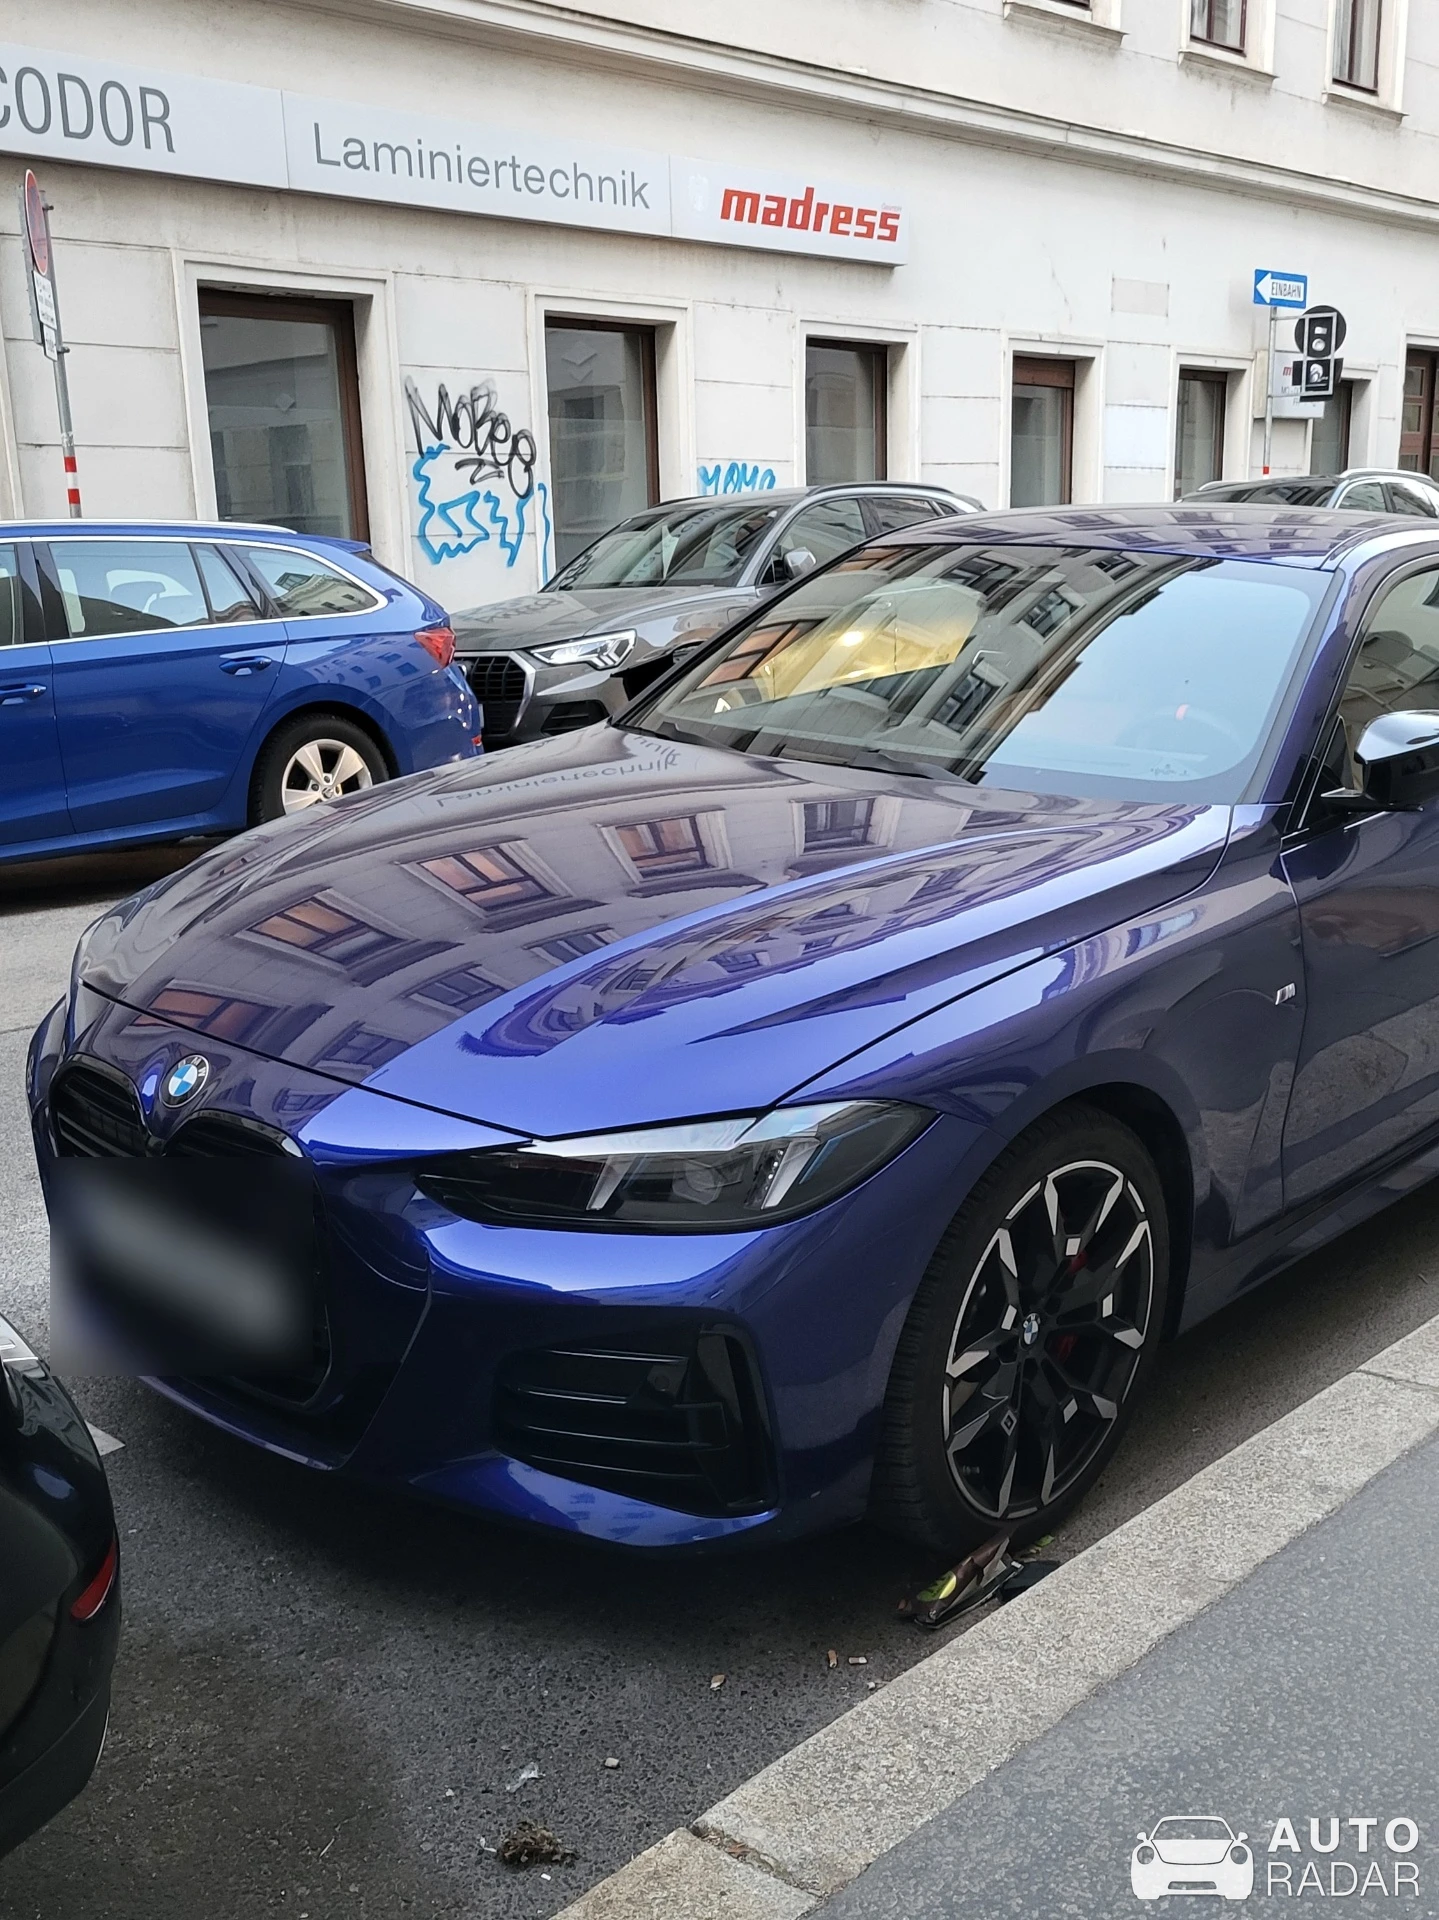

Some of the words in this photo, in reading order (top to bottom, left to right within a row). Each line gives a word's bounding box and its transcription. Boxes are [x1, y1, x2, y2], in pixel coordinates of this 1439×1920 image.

[313, 122, 650, 209] Laminiertechnik
[720, 186, 900, 242] madress
[1271, 281, 1301, 298] EINBAHN
[177, 1056, 207, 1077] BMW
